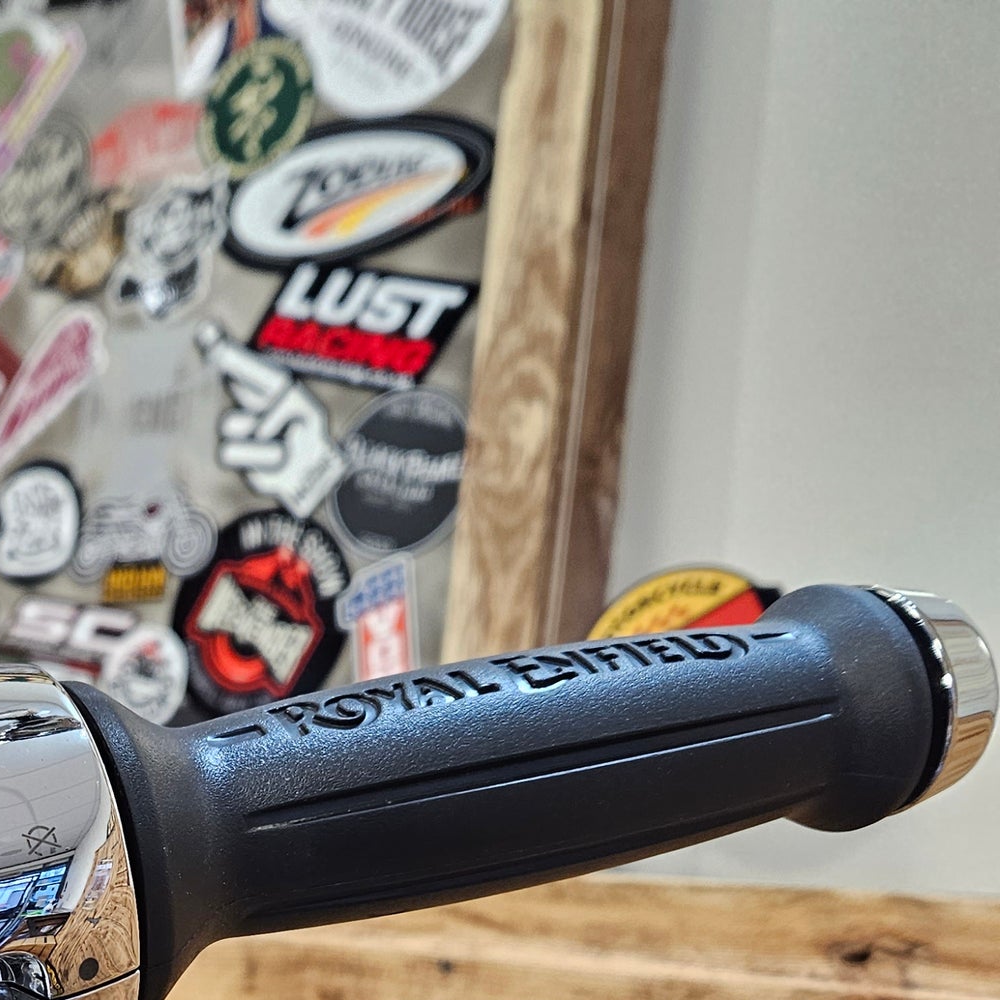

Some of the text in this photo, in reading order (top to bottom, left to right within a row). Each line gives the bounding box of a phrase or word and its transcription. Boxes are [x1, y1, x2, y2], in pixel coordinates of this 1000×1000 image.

[275, 261, 469, 340] LUST
[256, 314, 435, 376] RACING
[267, 632, 750, 738] ROYAL ENFIELD
